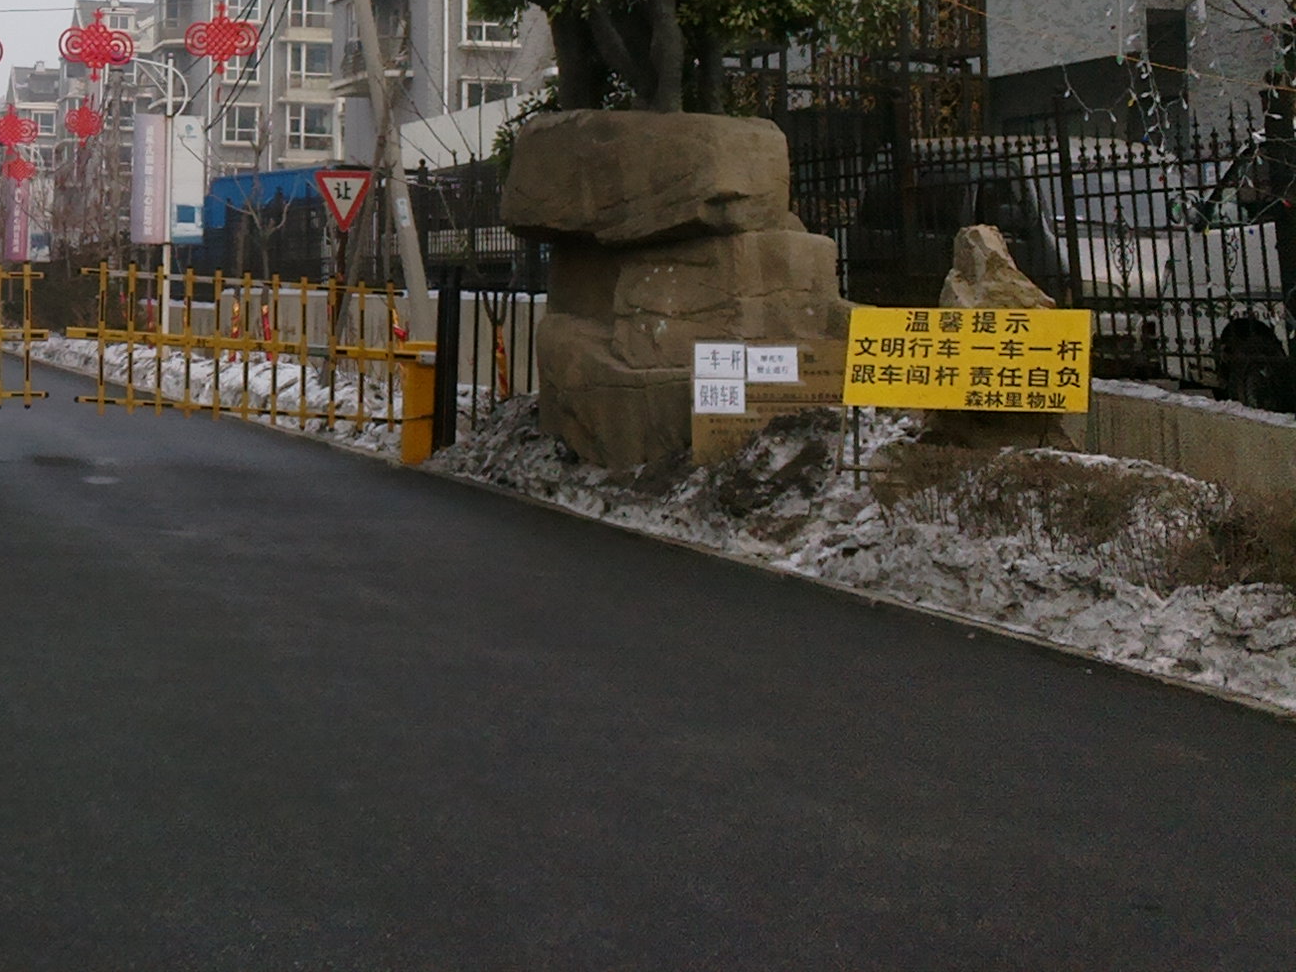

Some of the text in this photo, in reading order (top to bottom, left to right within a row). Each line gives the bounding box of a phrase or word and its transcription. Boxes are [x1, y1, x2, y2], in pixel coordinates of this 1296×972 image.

[334, 181, 352, 200] 让
[905, 311, 1031, 334] 温馨提示
[700, 349, 741, 370] 一车一杆
[854, 337, 1083, 361] 文明行车 一车一杆
[851, 364, 1081, 389] 跟车闯杆 责任自负
[700, 384, 740, 408] 保持车距
[964, 390, 1067, 410] 森林里物业
